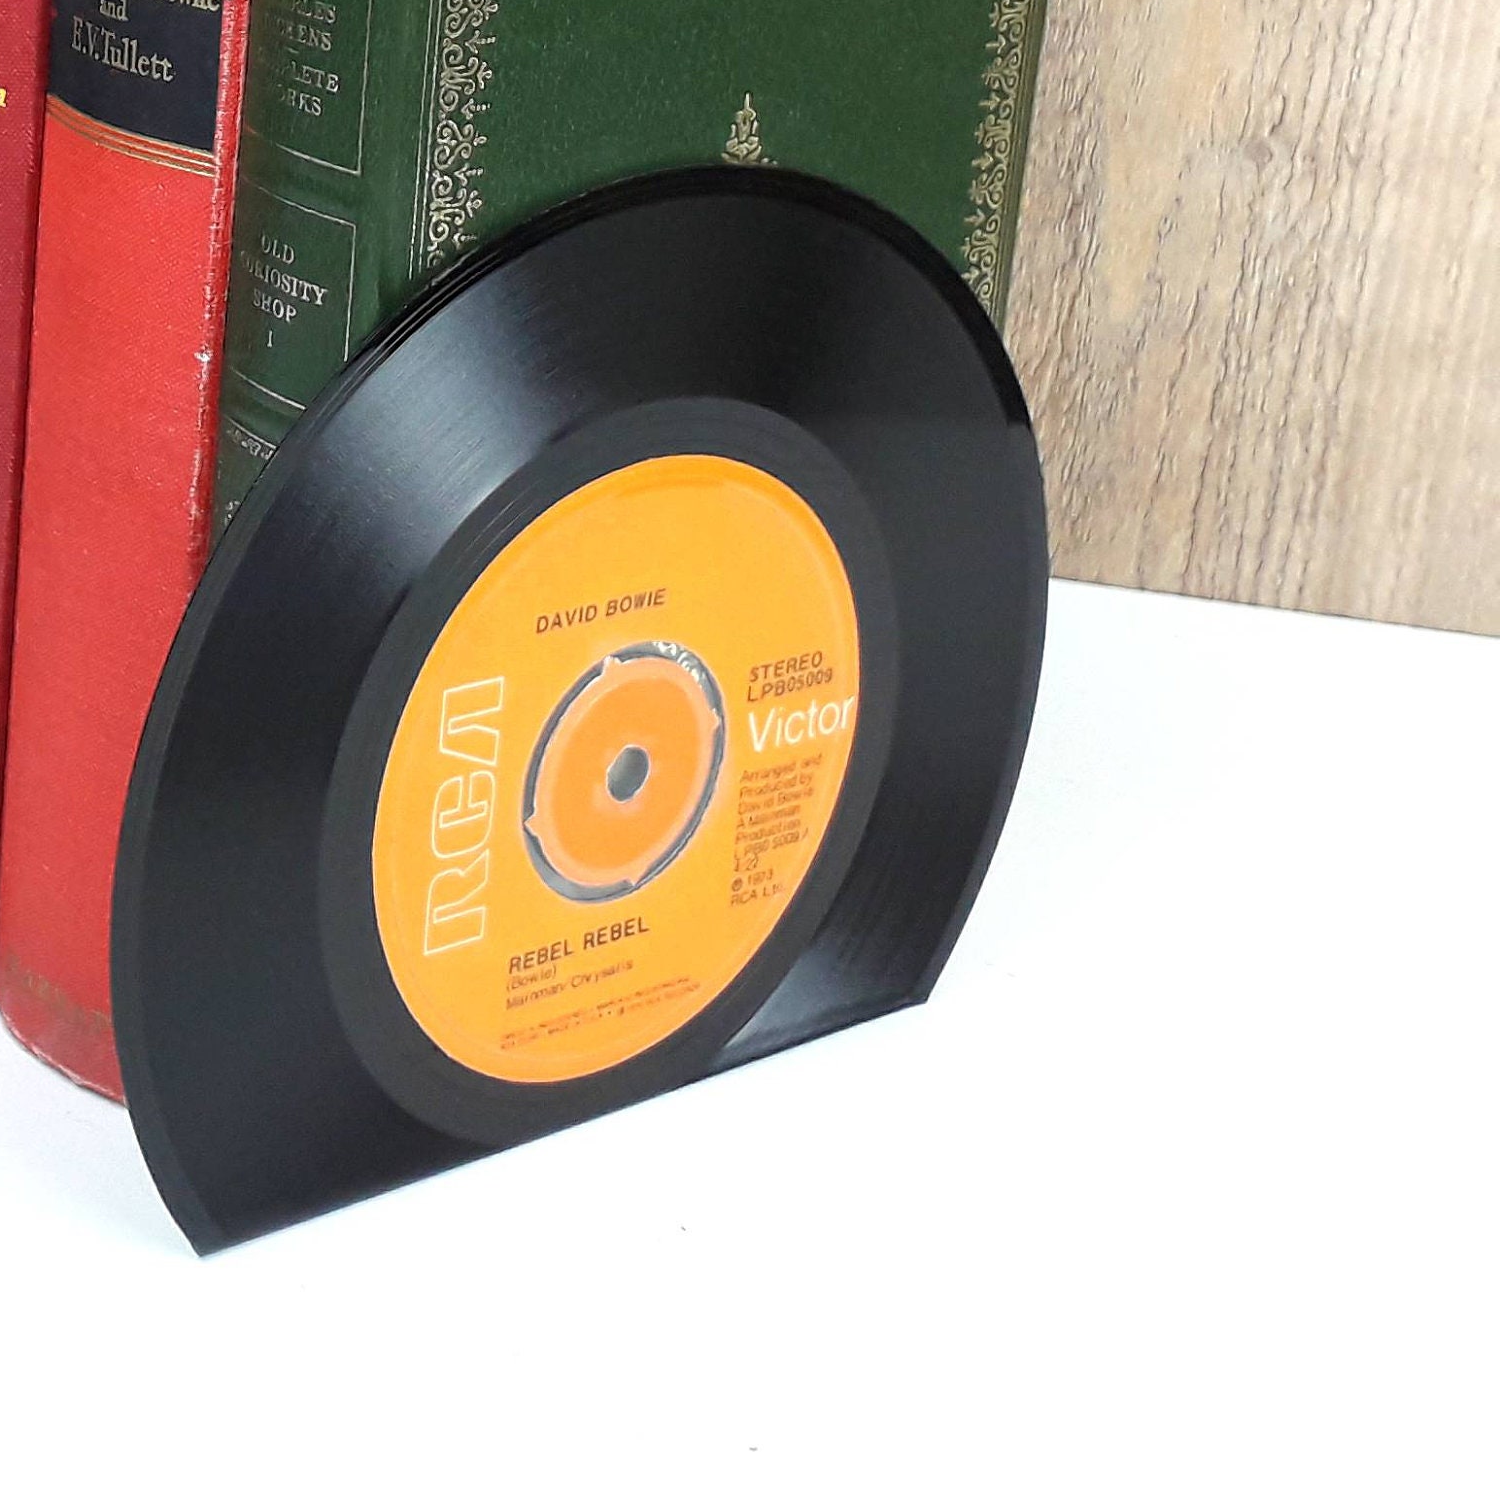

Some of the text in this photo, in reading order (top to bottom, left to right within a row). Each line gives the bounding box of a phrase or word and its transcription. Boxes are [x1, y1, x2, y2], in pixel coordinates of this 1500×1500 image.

[261, 233, 294, 264] OLD
[253, 288, 297, 322] SHOP
[536, 588, 666, 633] DAVID BOWIE
[749, 650, 823, 683] STEREO
[748, 695, 854, 753] Victor
[424, 676, 505, 955] RCA
[508, 916, 650, 975] REBEL REBEL
